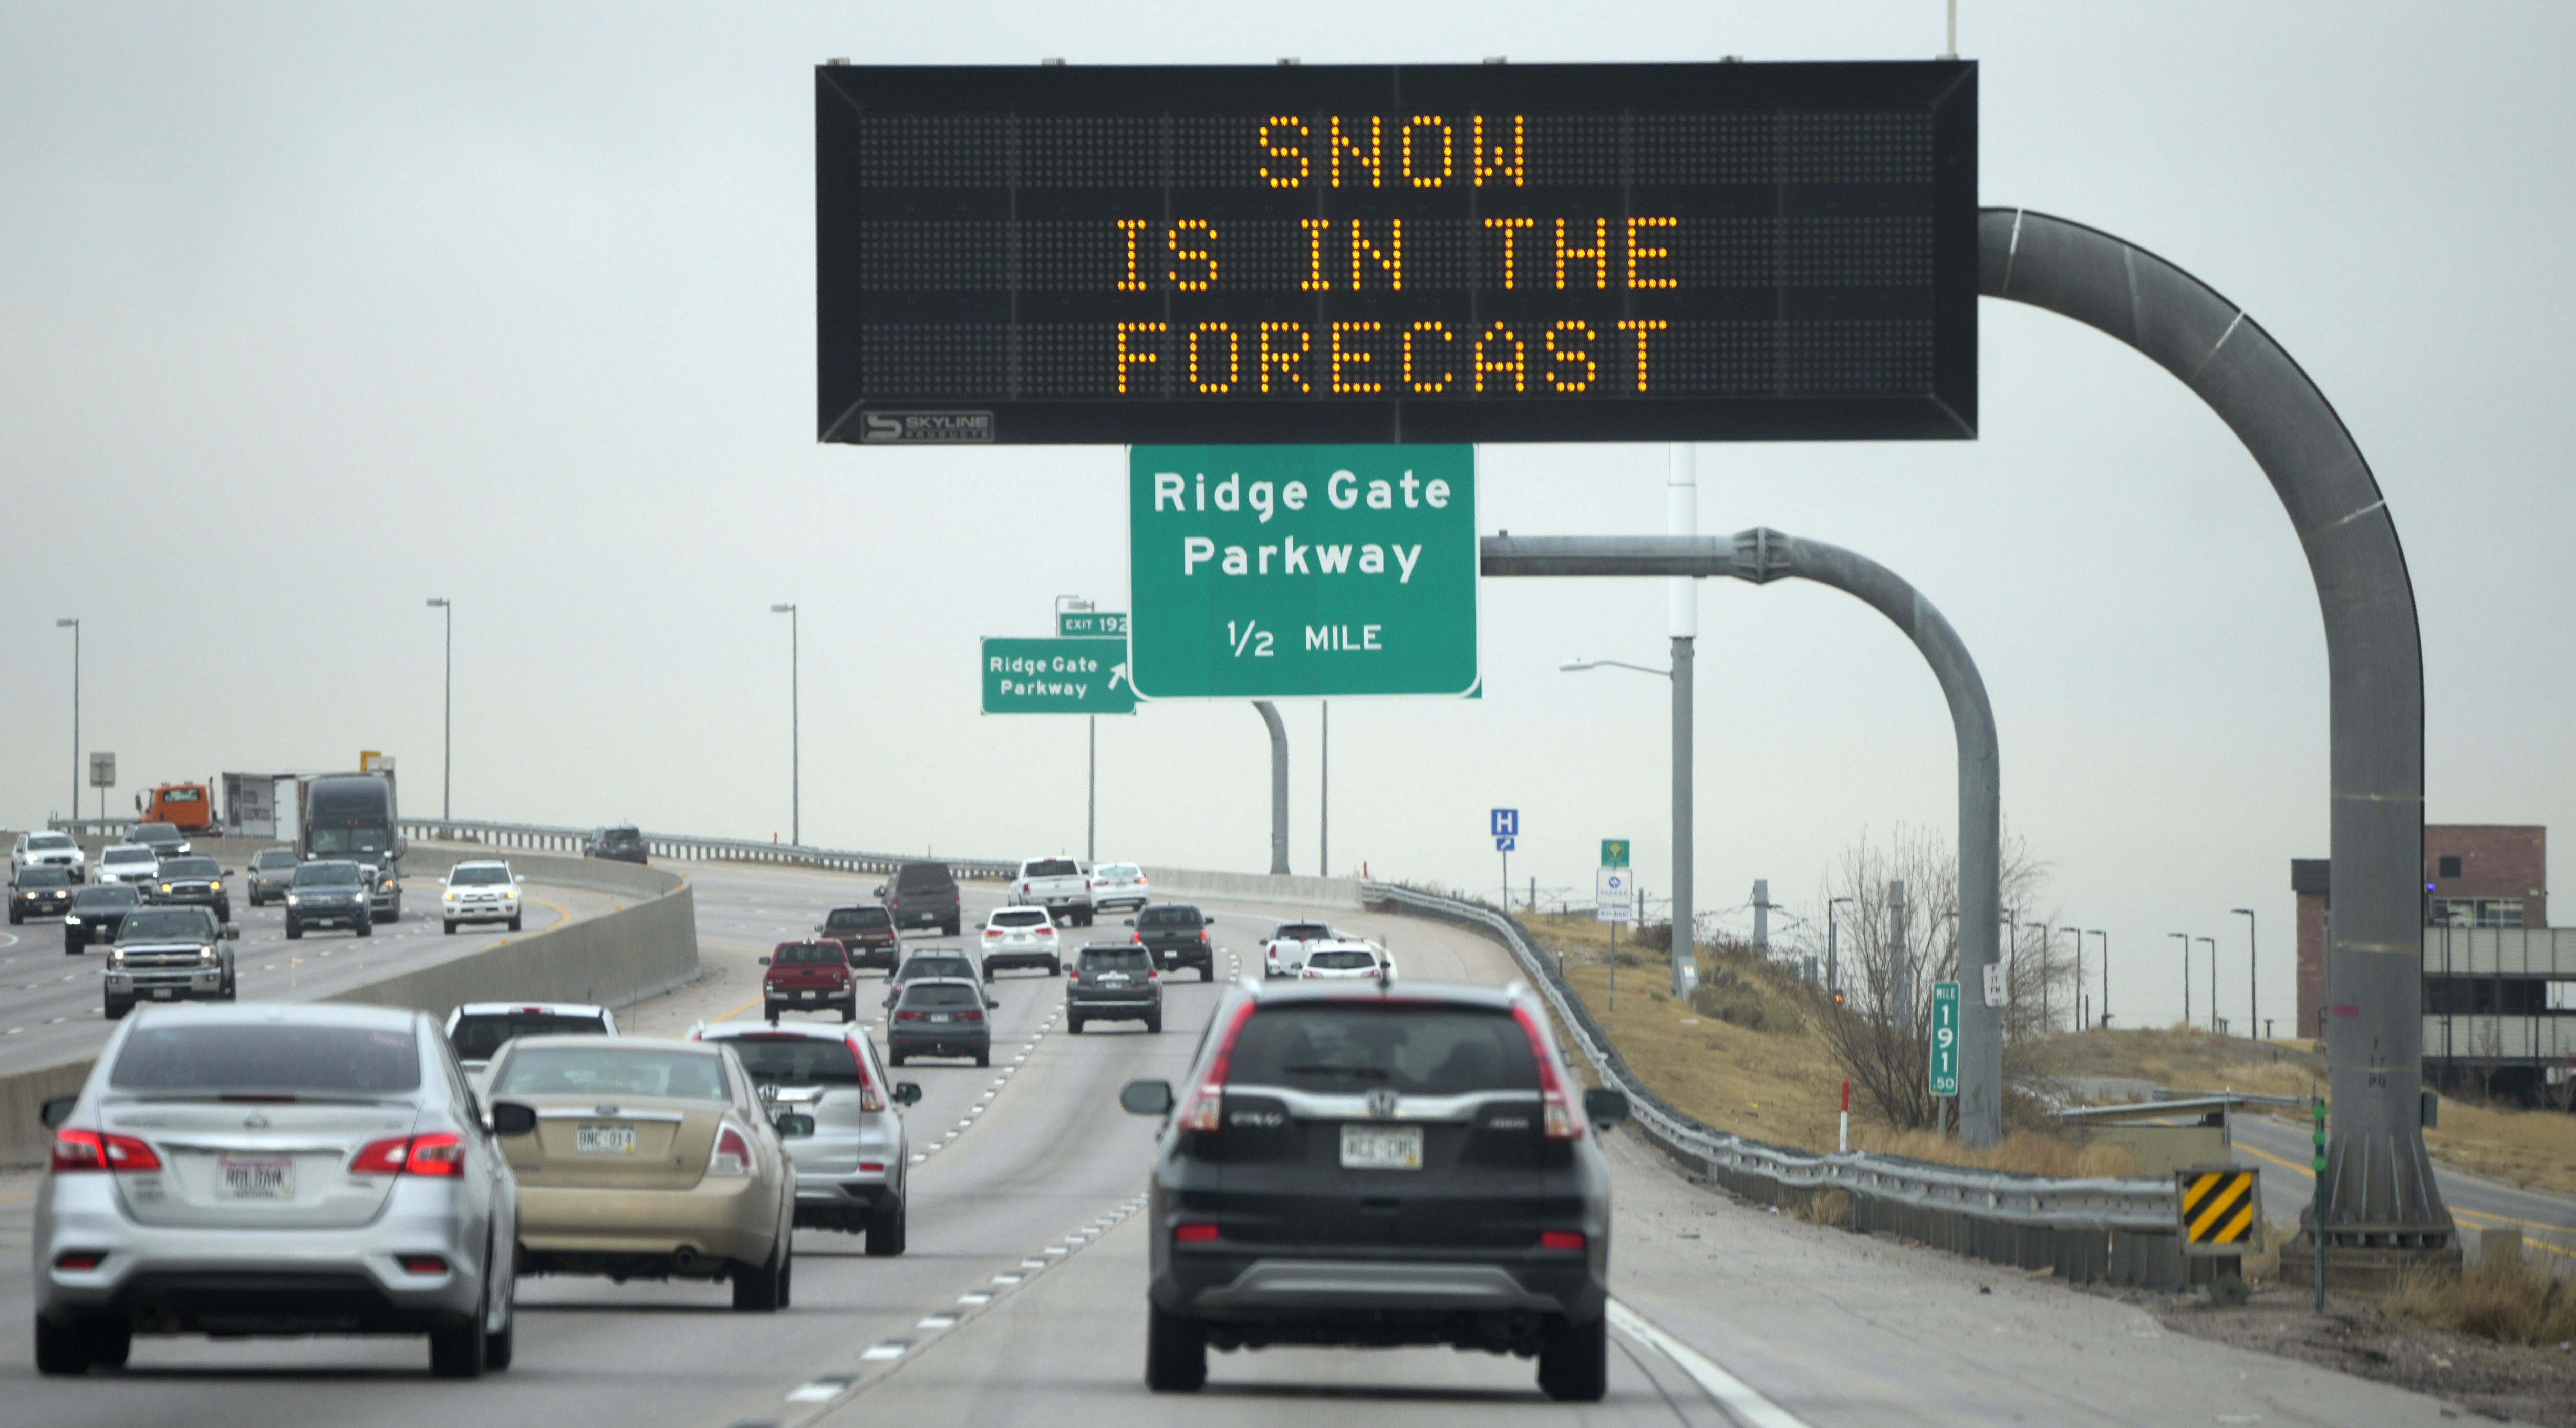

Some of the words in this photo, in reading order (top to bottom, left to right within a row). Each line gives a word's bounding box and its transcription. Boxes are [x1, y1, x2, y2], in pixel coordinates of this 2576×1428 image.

[1259, 114, 1524, 188] SNOW
[1117, 219, 1218, 291] IS
[1301, 219, 1401, 291] IN
[1484, 217, 1678, 290] THE
[1117, 320, 1668, 394] FORECAST
[905, 416, 988, 428] SKYLINE
[1155, 472, 1307, 524] Ridge
[1328, 469, 1451, 510] Gate
[1184, 535, 1422, 584] Parkway
[1065, 619, 1093, 630] EXIT
[1227, 619, 1274, 657] 1/2
[1305, 624, 1382, 651] MILE
[990, 656, 1047, 677] Ridge
[1053, 656, 1099, 673] Gate
[1001, 679, 1087, 700] Parkway
[1497, 811, 1513, 833] H
[1936, 987, 1956, 999] MILE
